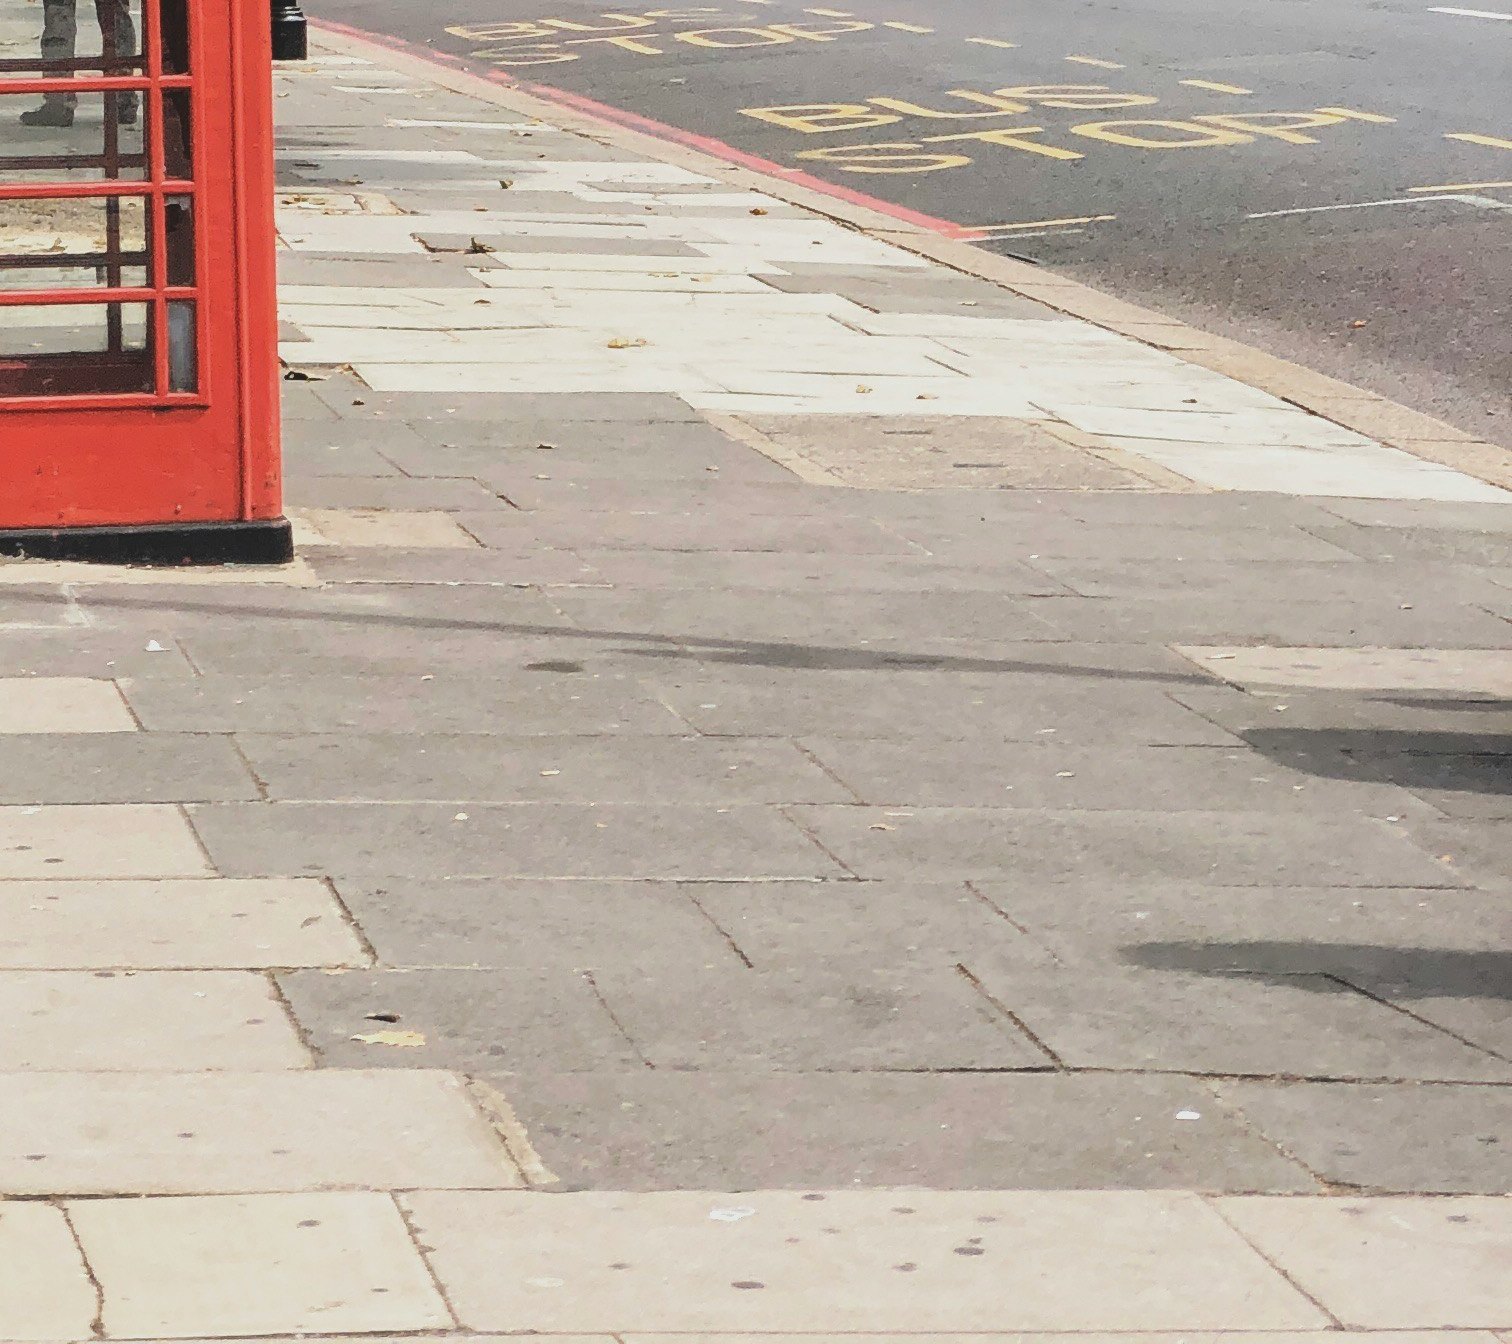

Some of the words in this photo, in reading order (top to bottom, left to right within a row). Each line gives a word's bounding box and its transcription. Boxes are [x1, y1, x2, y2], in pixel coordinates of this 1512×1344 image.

[444, 7, 757, 42] BUS
[470, 21, 875, 66] STOP
[737, 84, 1160, 133] BUS
[797, 110, 1346, 174] STOP
